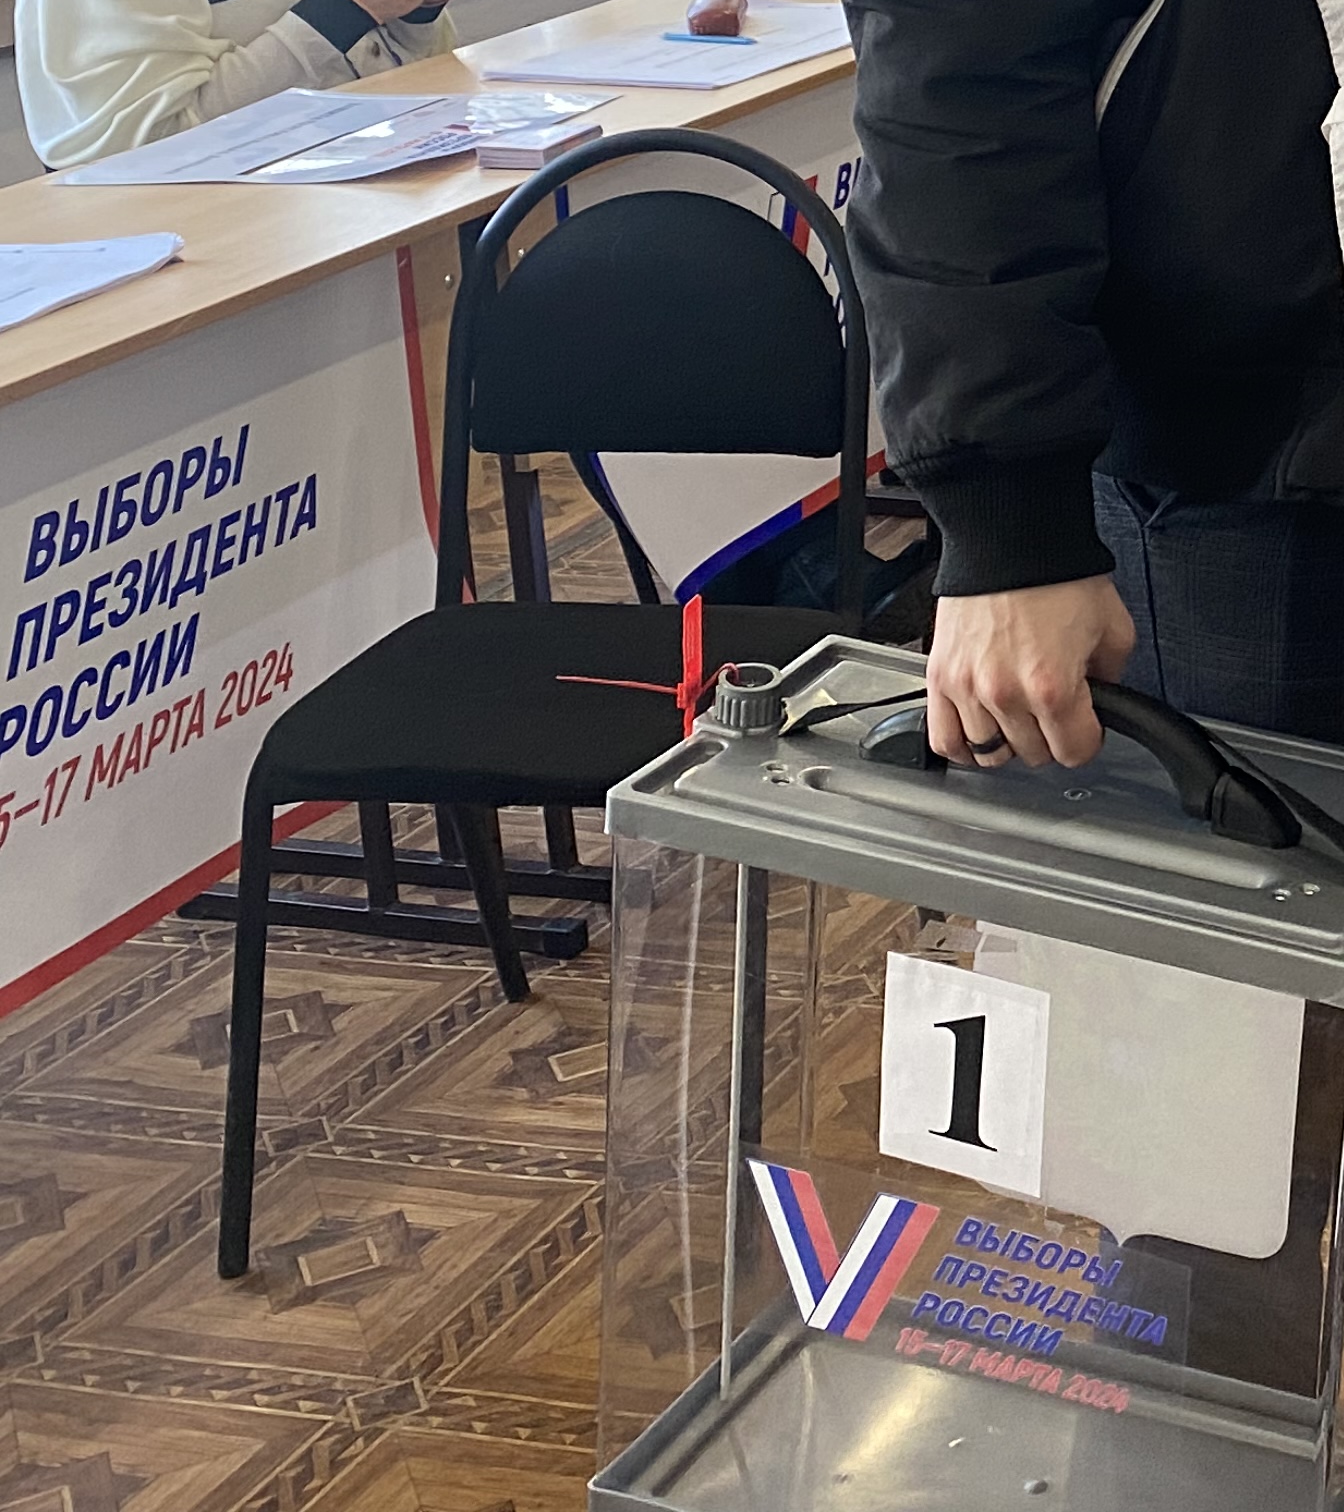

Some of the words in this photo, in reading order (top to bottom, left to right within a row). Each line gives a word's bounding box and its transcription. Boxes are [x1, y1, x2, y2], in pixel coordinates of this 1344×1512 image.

[24, 424, 250, 583] ВЫБОРЫ
[7, 474, 317, 681] ПРЕЗИДЕНТА
[0, 612, 200, 758] РОССИИ
[85, 688, 205, 802] МАРТА
[215, 642, 293, 730] 2024
[928, 1015, 998, 1152] 1
[934, 1254, 1168, 1346] ПРЕЗИДЕНТА
[954, 1216, 1123, 1288] ВЫБОРЫ
[911, 1291, 1063, 1356] РОССИИ
[969, 1348, 1062, 1394] МАРТА
[1062, 1374, 1131, 1414] 2024
